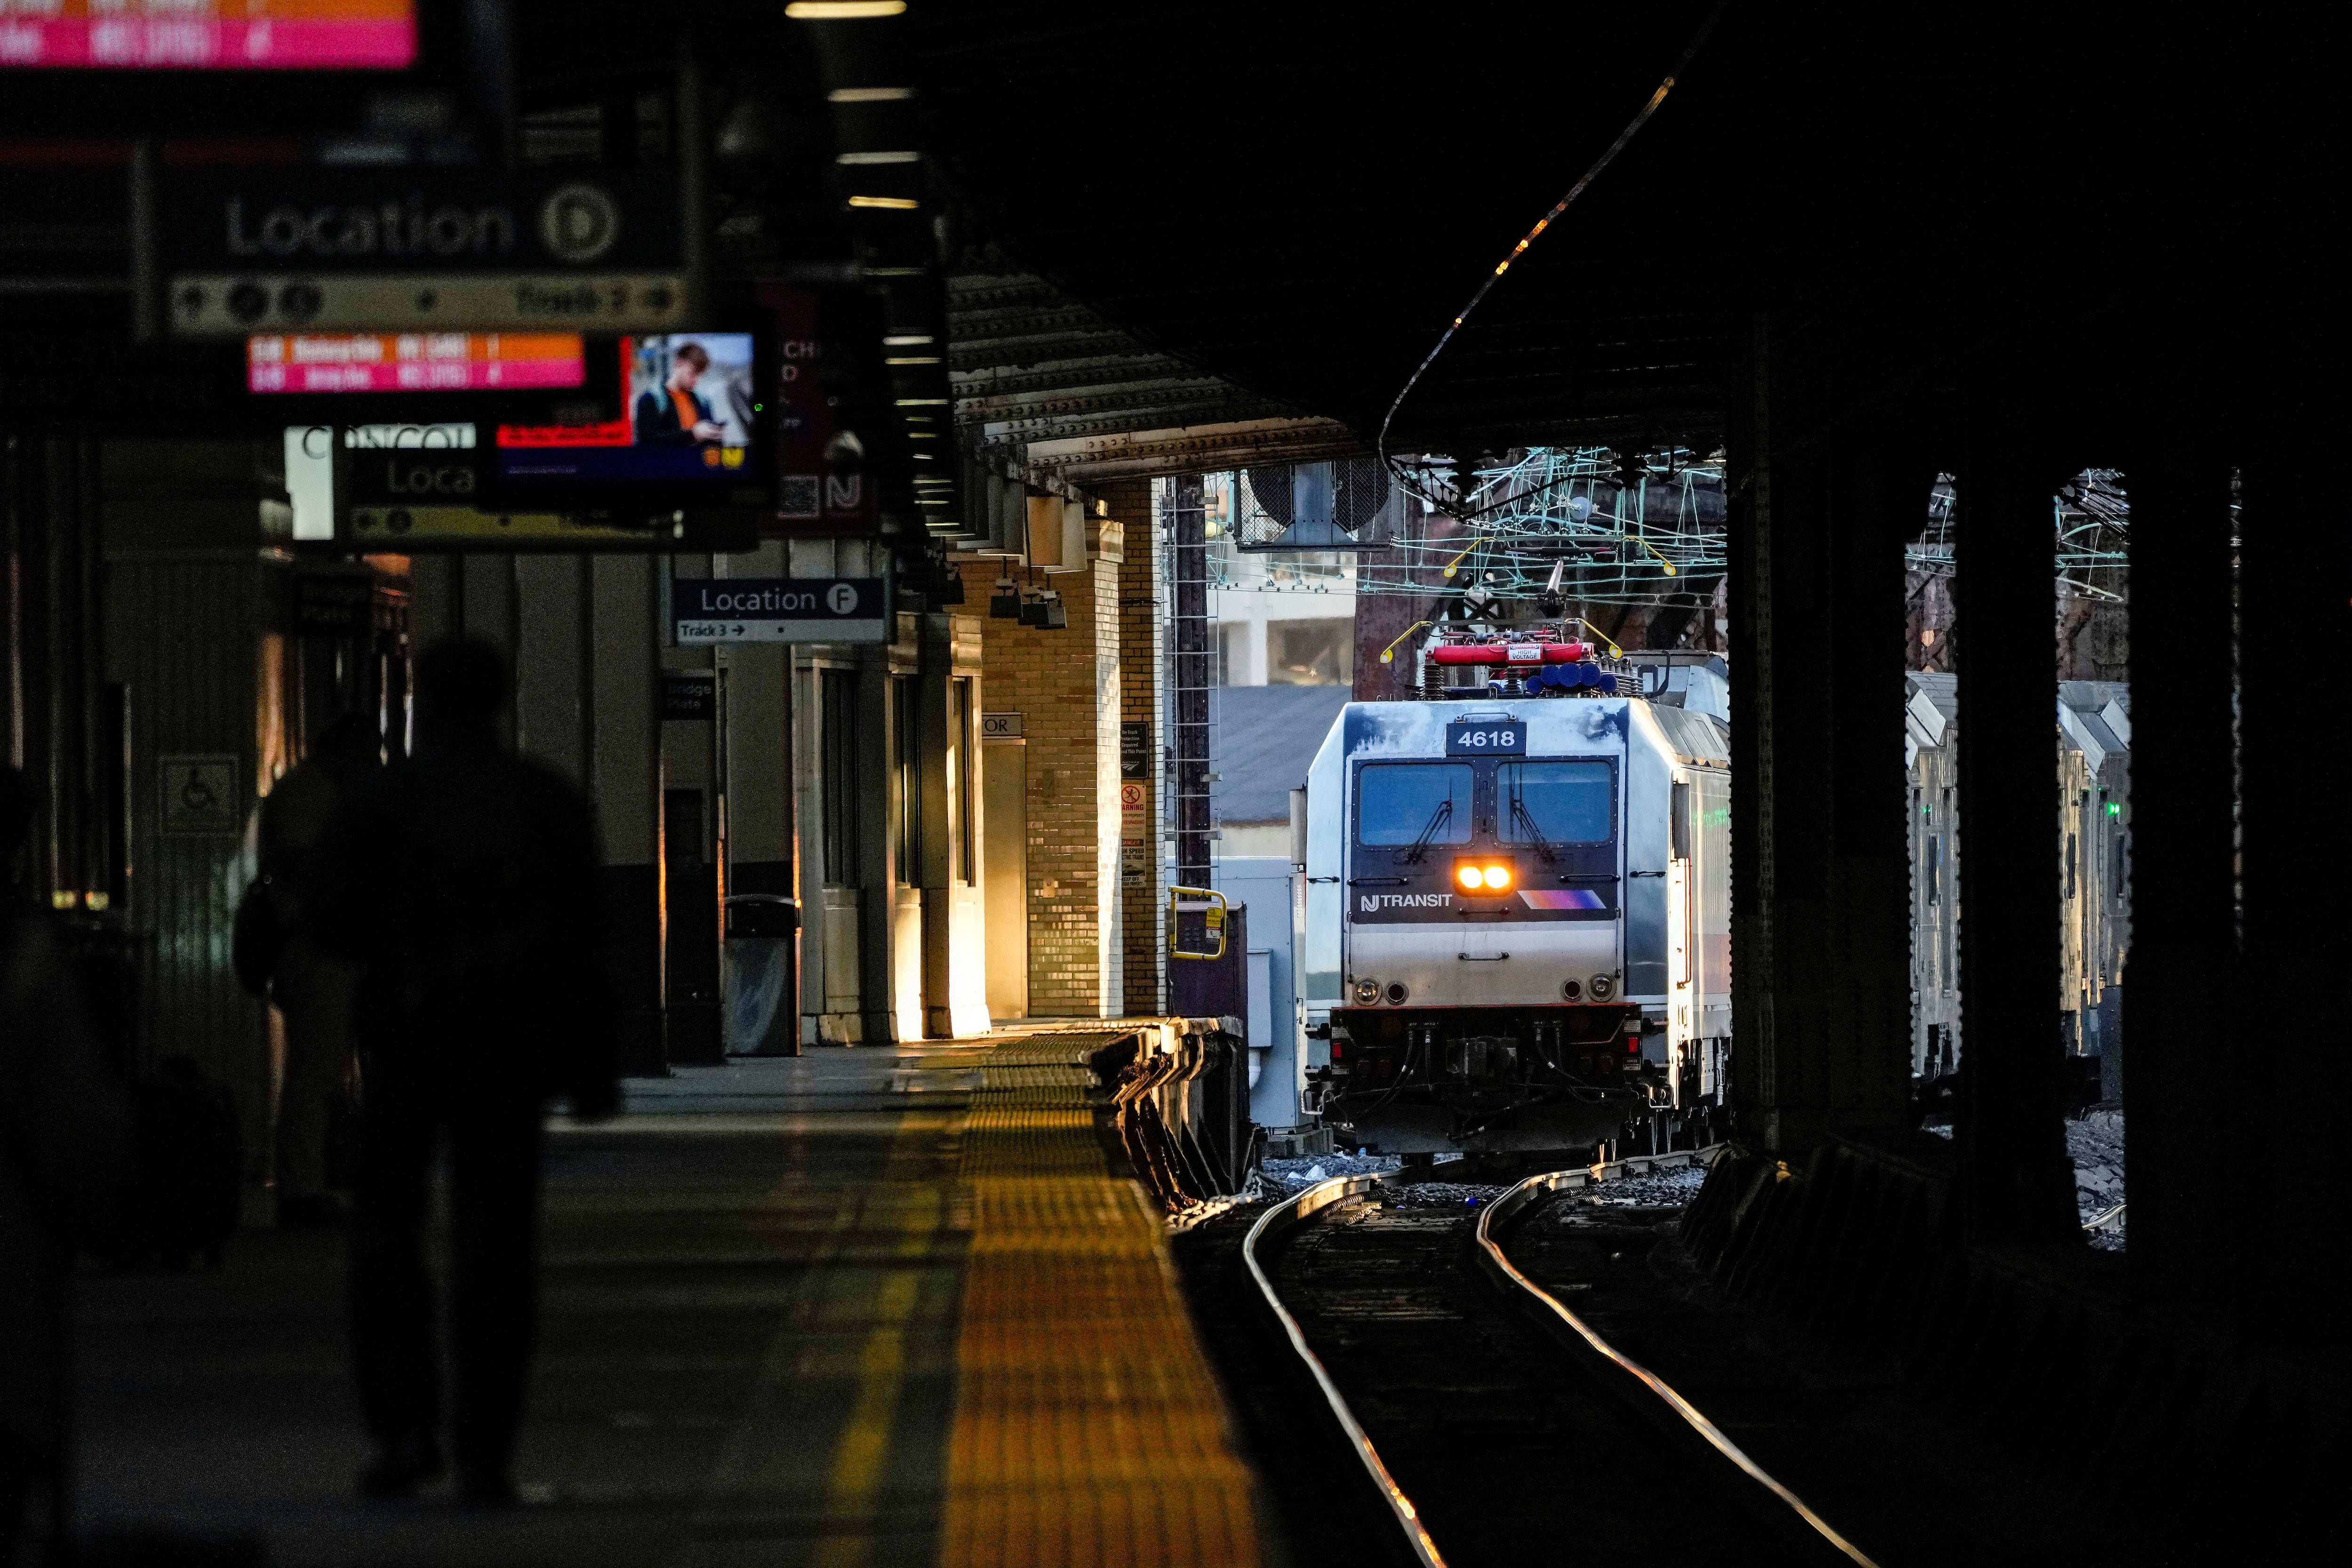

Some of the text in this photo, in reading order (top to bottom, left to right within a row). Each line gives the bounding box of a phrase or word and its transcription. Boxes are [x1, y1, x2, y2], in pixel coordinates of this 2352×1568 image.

[223, 191, 607, 257] Location D
[701, 587, 849, 611] Location F
[681, 624, 727, 637] Track 3
[982, 718, 1008, 732] OR
[1457, 730, 1515, 748] 4618
[1360, 894, 1453, 912] NJ TRANSIT
